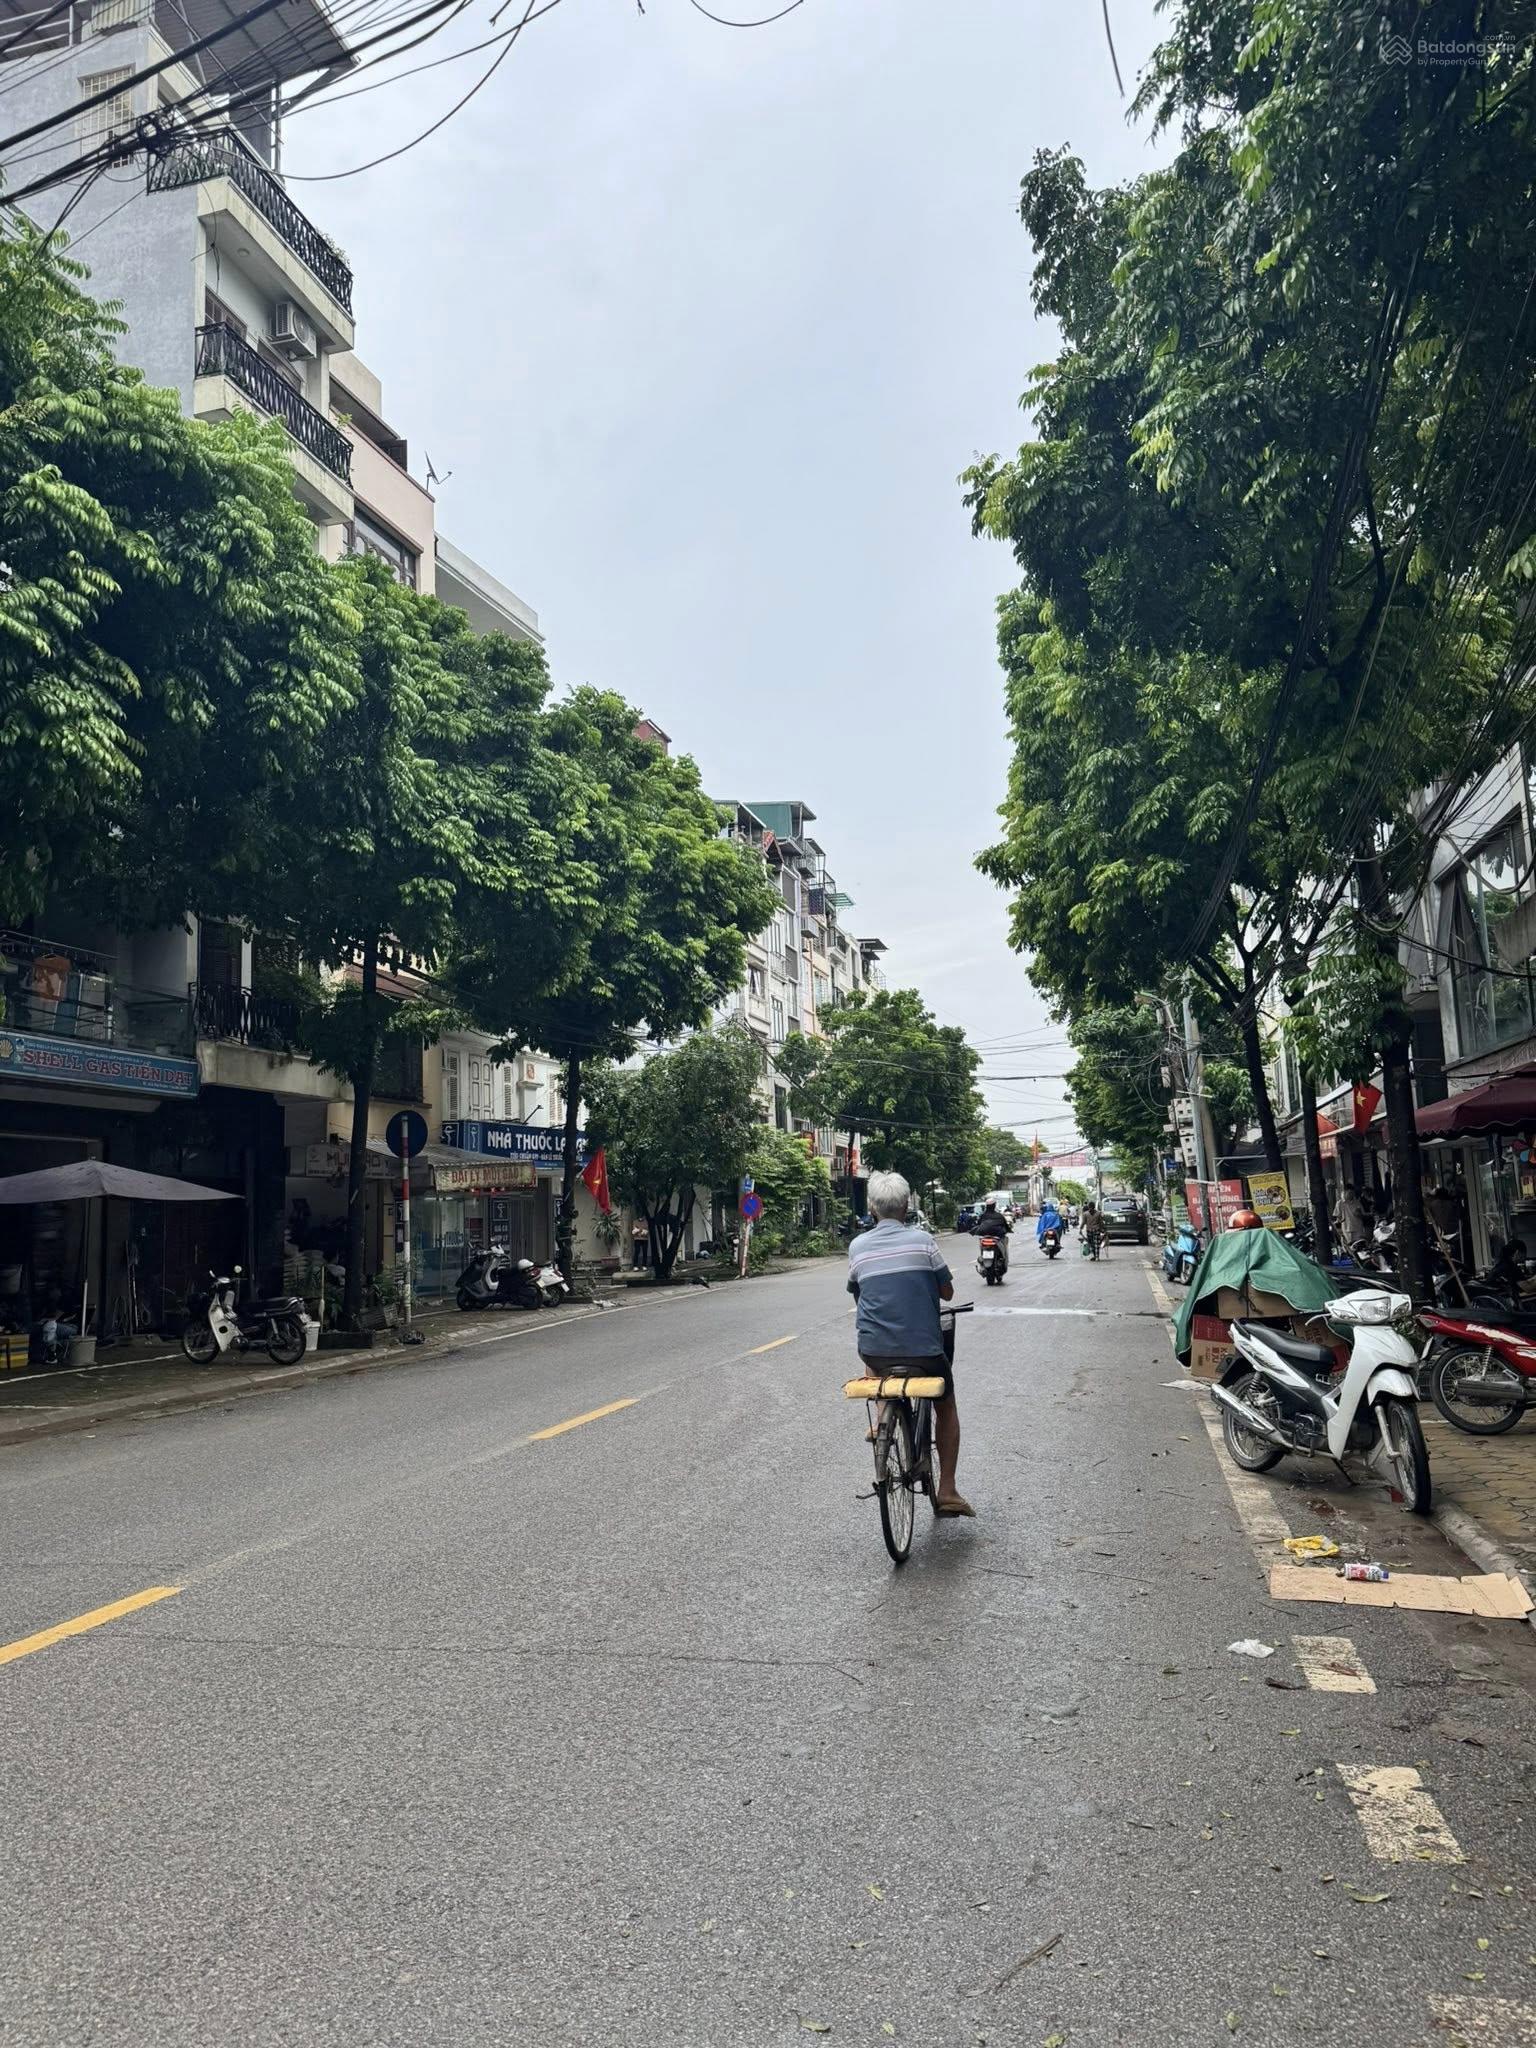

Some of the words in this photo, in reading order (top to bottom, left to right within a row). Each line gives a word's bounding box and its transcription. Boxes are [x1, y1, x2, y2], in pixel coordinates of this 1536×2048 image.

[23, 1049, 83, 1072] SHELL
[85, 1057, 121, 1076] GAS
[487, 1127, 511, 1148] NHÀ
[515, 1129, 553, 1151] THUỐC
